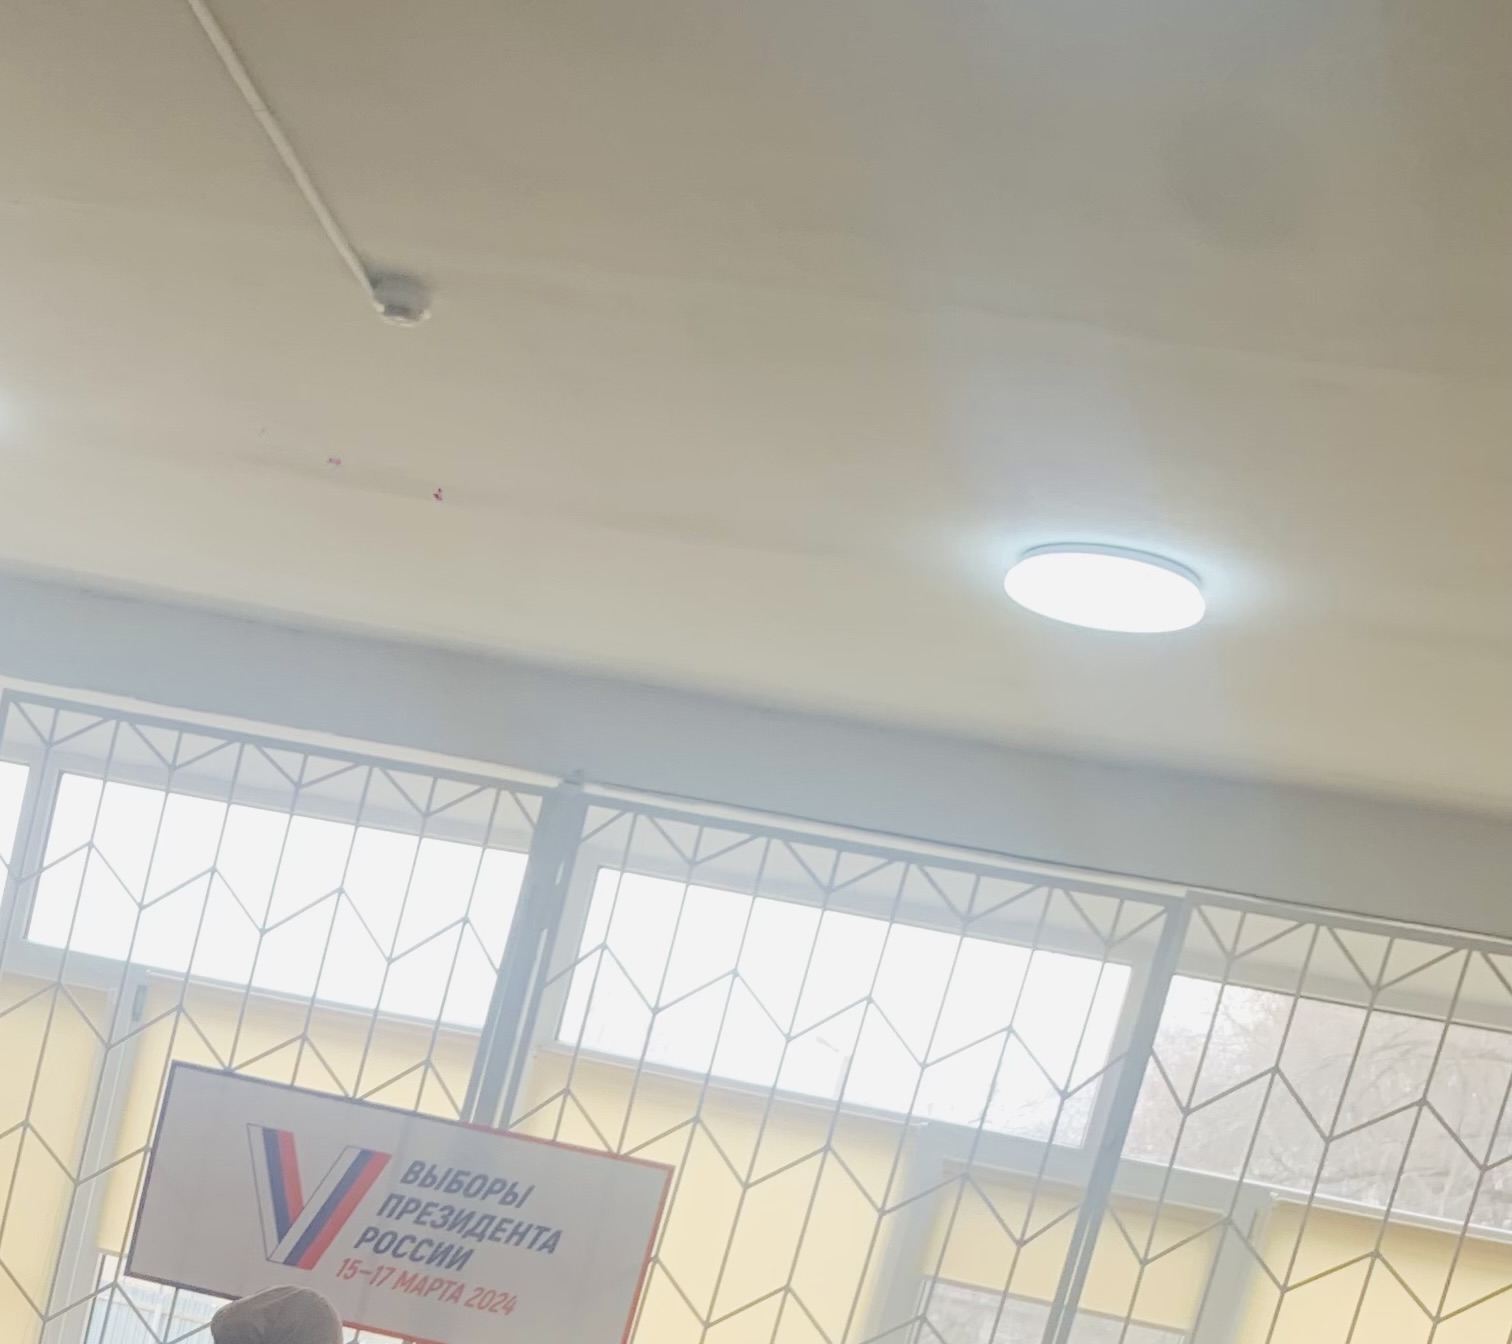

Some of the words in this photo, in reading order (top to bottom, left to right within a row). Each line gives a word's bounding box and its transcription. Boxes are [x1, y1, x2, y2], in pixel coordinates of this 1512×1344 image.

[400, 1160, 536, 1209] ВЫБОРЫ
[376, 1192, 564, 1254] ПРЕЗИДЕНТА
[353, 1226, 475, 1272] РОССИИ
[392, 1269, 465, 1304] МАРТА
[464, 1287, 518, 1316] 2024
